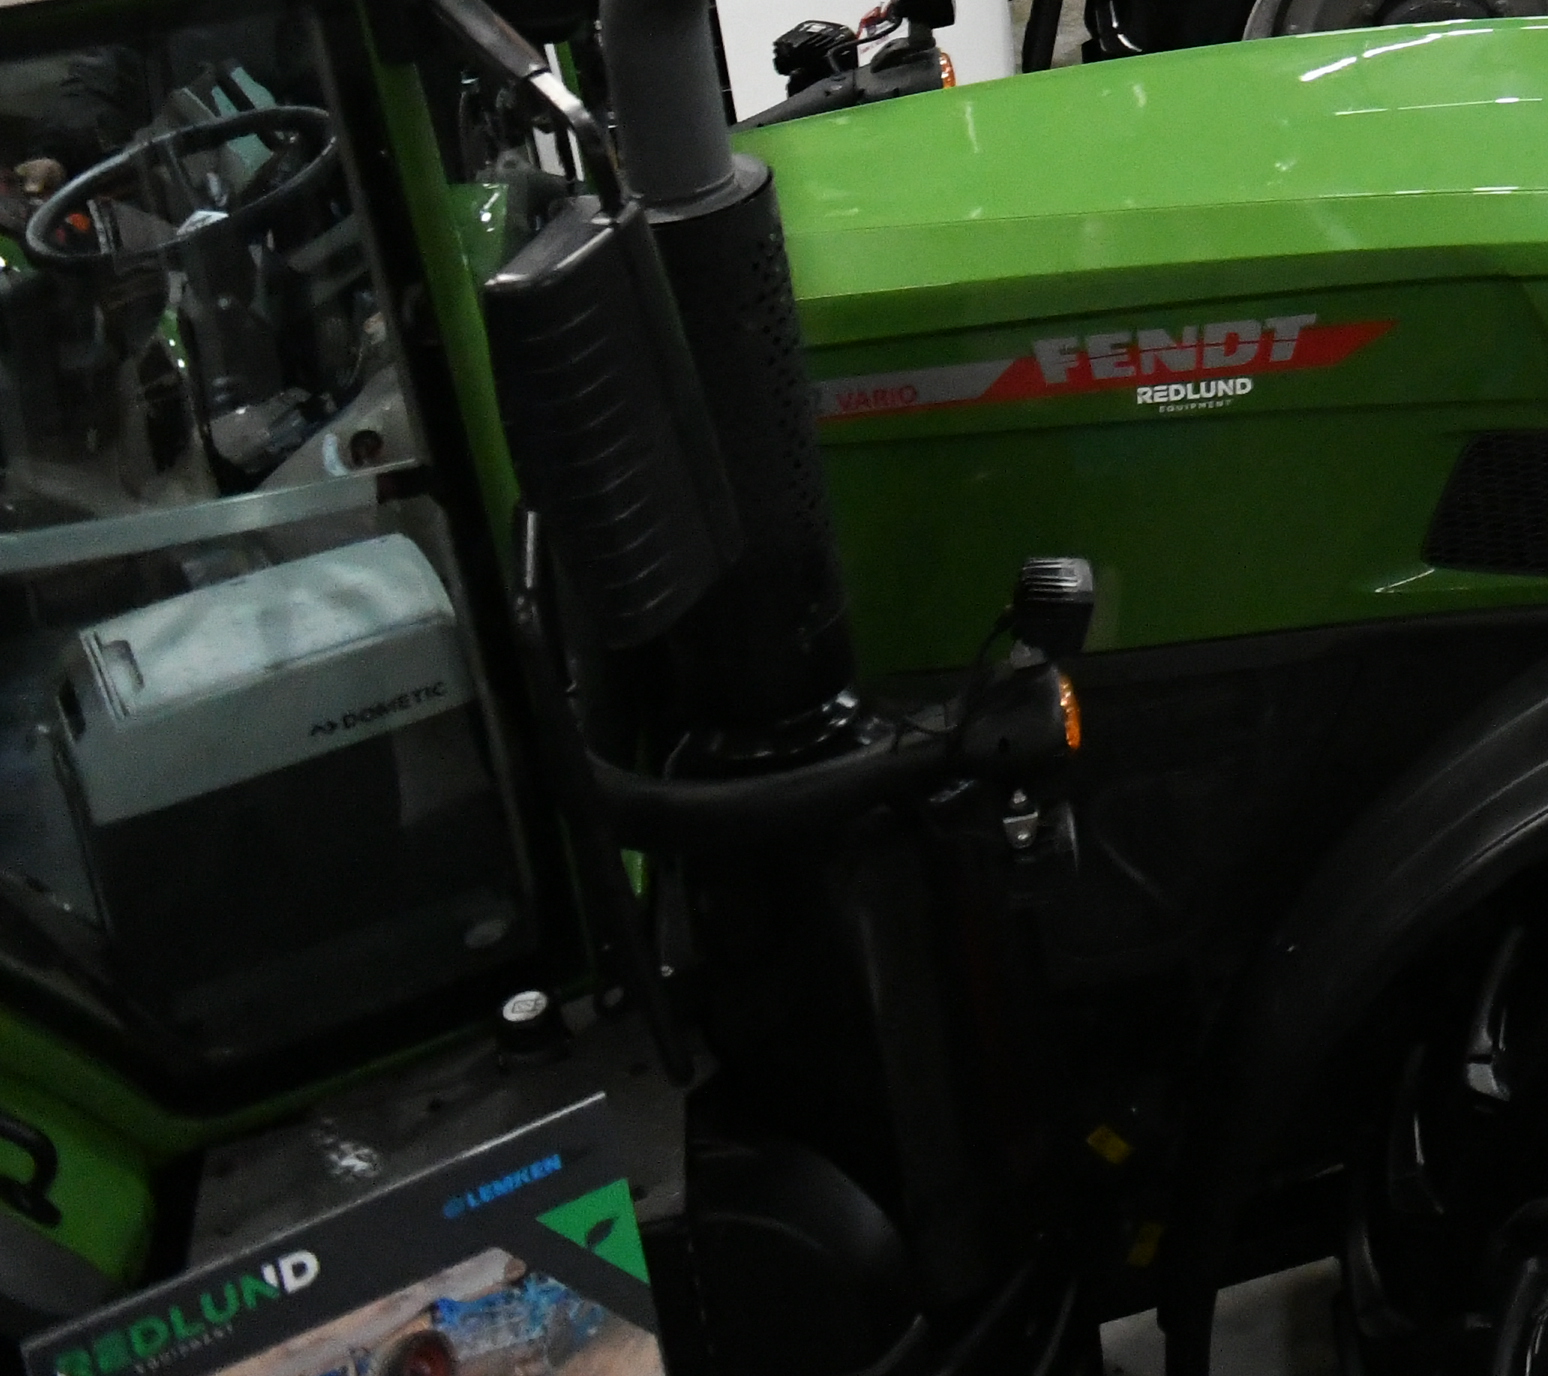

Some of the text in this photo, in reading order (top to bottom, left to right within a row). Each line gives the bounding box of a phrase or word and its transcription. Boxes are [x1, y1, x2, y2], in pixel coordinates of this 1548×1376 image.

[836, 384, 918, 412] VARIO
[1158, 398, 1233, 414] EQUIPMENT
[340, 681, 447, 733] DOMETIC
[465, 1153, 562, 1208] LEMKEN
